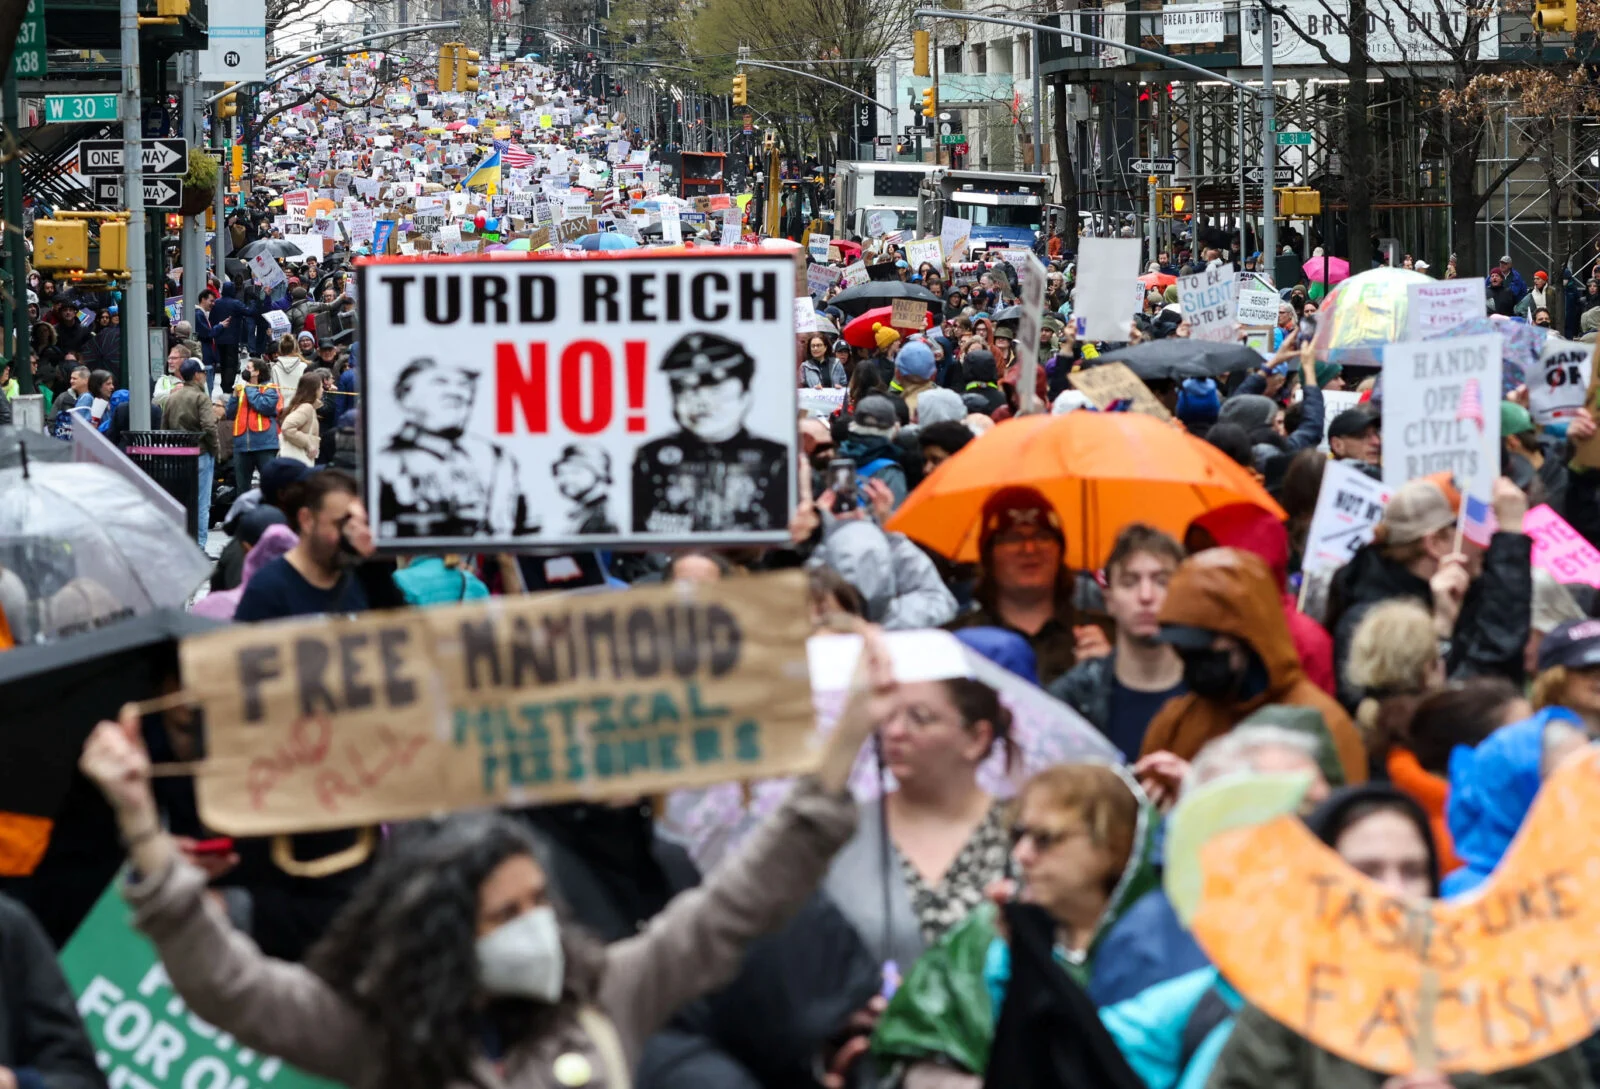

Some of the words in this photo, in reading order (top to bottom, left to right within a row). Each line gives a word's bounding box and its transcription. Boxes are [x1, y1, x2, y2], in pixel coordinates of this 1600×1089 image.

[1163, 13, 1187, 26] BREAD
[1195, 11, 1224, 24] BUTTER
[1307, 13, 1376, 36] BRED
[1407, 11, 1491, 34] BUTTR
[15, 50, 39, 73] x38
[226, 53, 238, 65] FN
[50, 99, 64, 118] W
[73, 98, 96, 118] 30
[104, 97, 114, 108] ST
[1279, 134, 1285, 144] E
[1289, 134, 1299, 144] 31
[91, 151, 120, 165] ONE
[142, 150, 168, 163] WAY
[1135, 162, 1149, 170] ONE
[1155, 162, 1170, 170] WAY
[1274, 170, 1290, 178] WAY
[143, 187, 168, 198] WAY
[421, 225, 441, 233] SILENC
[562, 218, 588, 235] TAX
[1178, 277, 1199, 289] TO
[1207, 271, 1221, 286] BE
[380, 274, 558, 325] TURD
[582, 272, 778, 322] REICH
[1183, 280, 1233, 312] SILENT
[1200, 312, 1214, 323] TO
[1217, 304, 1229, 320] BE
[1413, 346, 1488, 379] HANDS
[495, 338, 648, 435] NO!
[1546, 366, 1581, 387] OF
[1403, 419, 1469, 448] CIVIL
[237, 627, 418, 723] FREE
[75, 974, 188, 1081] FOR
